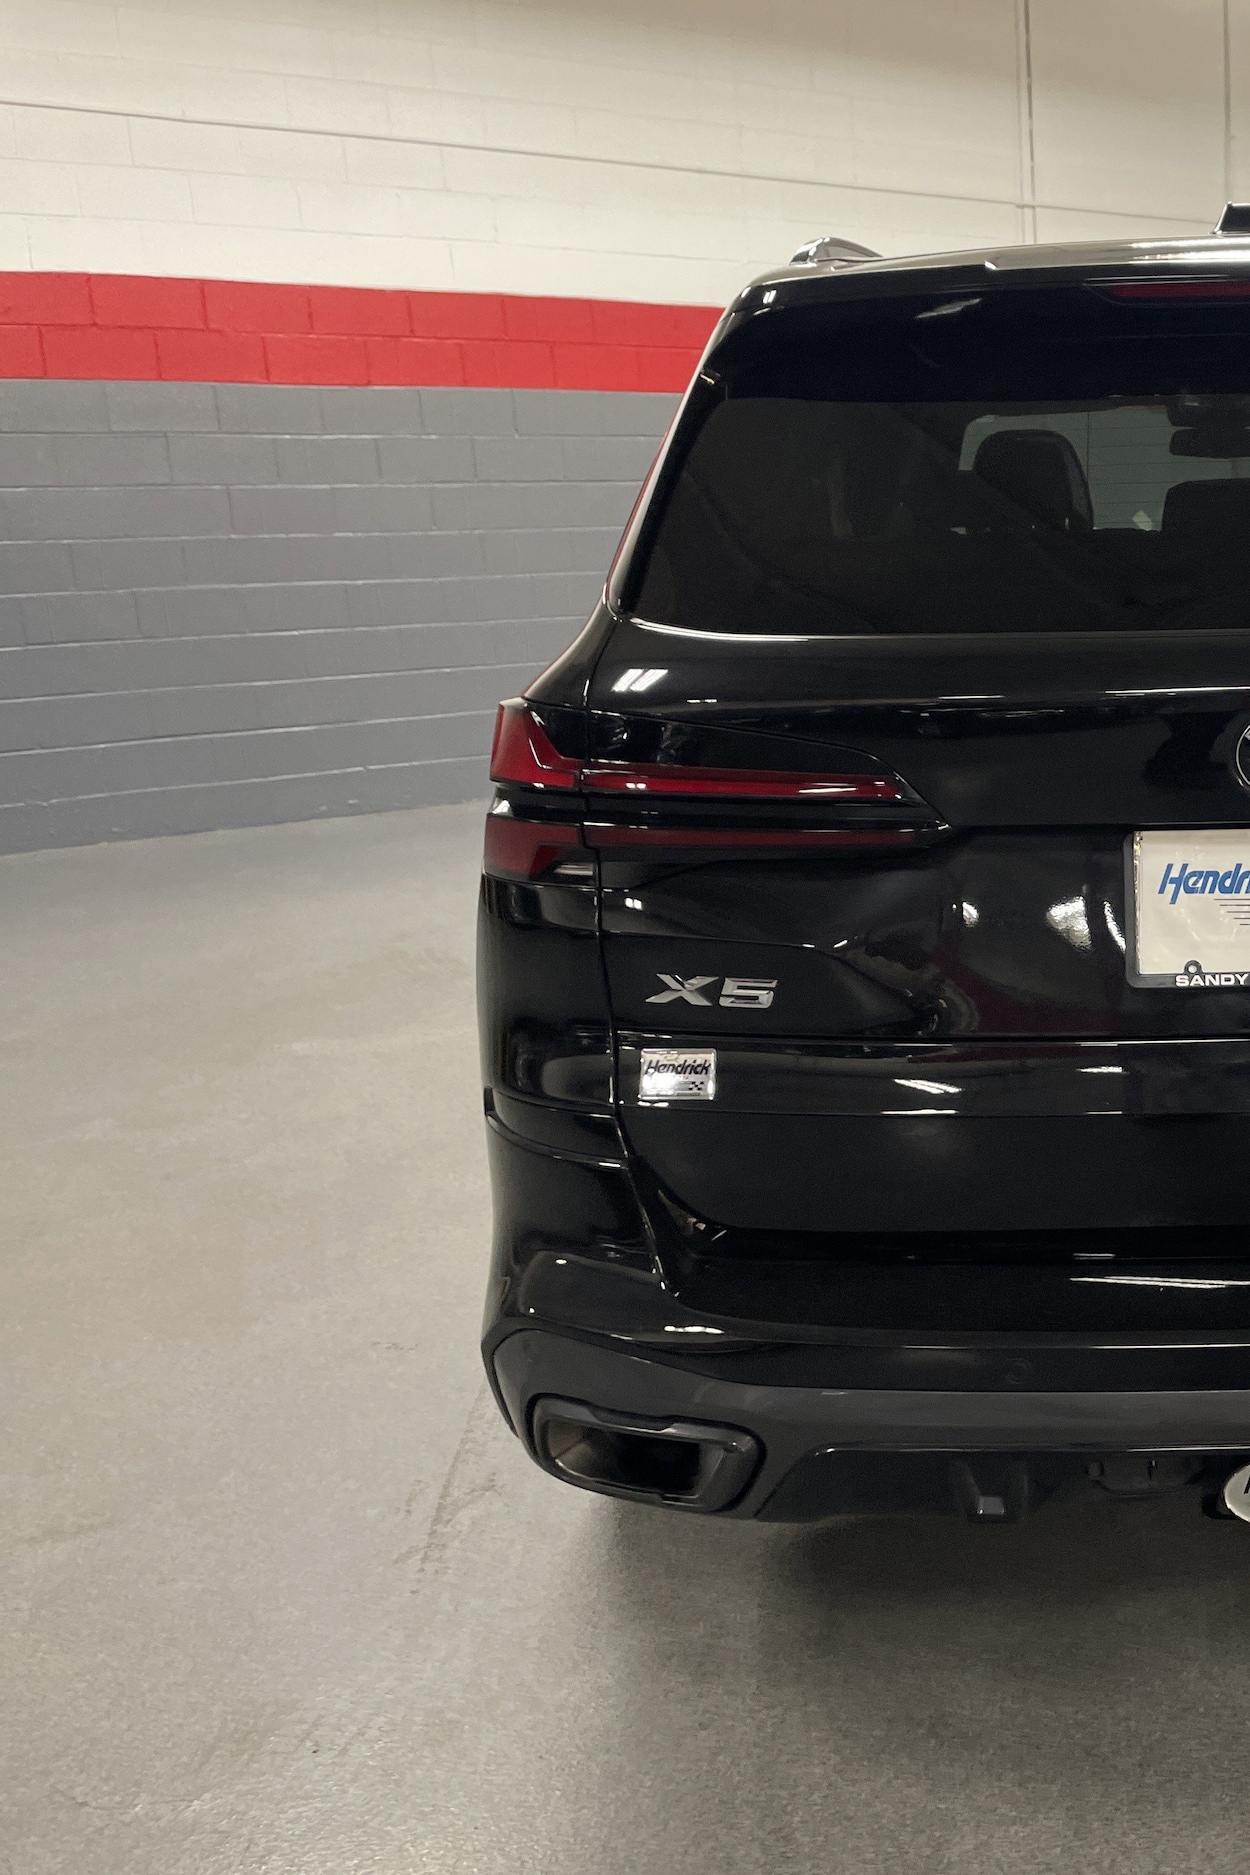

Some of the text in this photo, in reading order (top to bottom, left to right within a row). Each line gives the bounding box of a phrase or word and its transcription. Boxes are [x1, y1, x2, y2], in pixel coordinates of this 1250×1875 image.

[1175, 973, 1249, 987] SANDY
[645, 973, 778, 1009] X5
[644, 1059, 711, 1075] Hendrick
